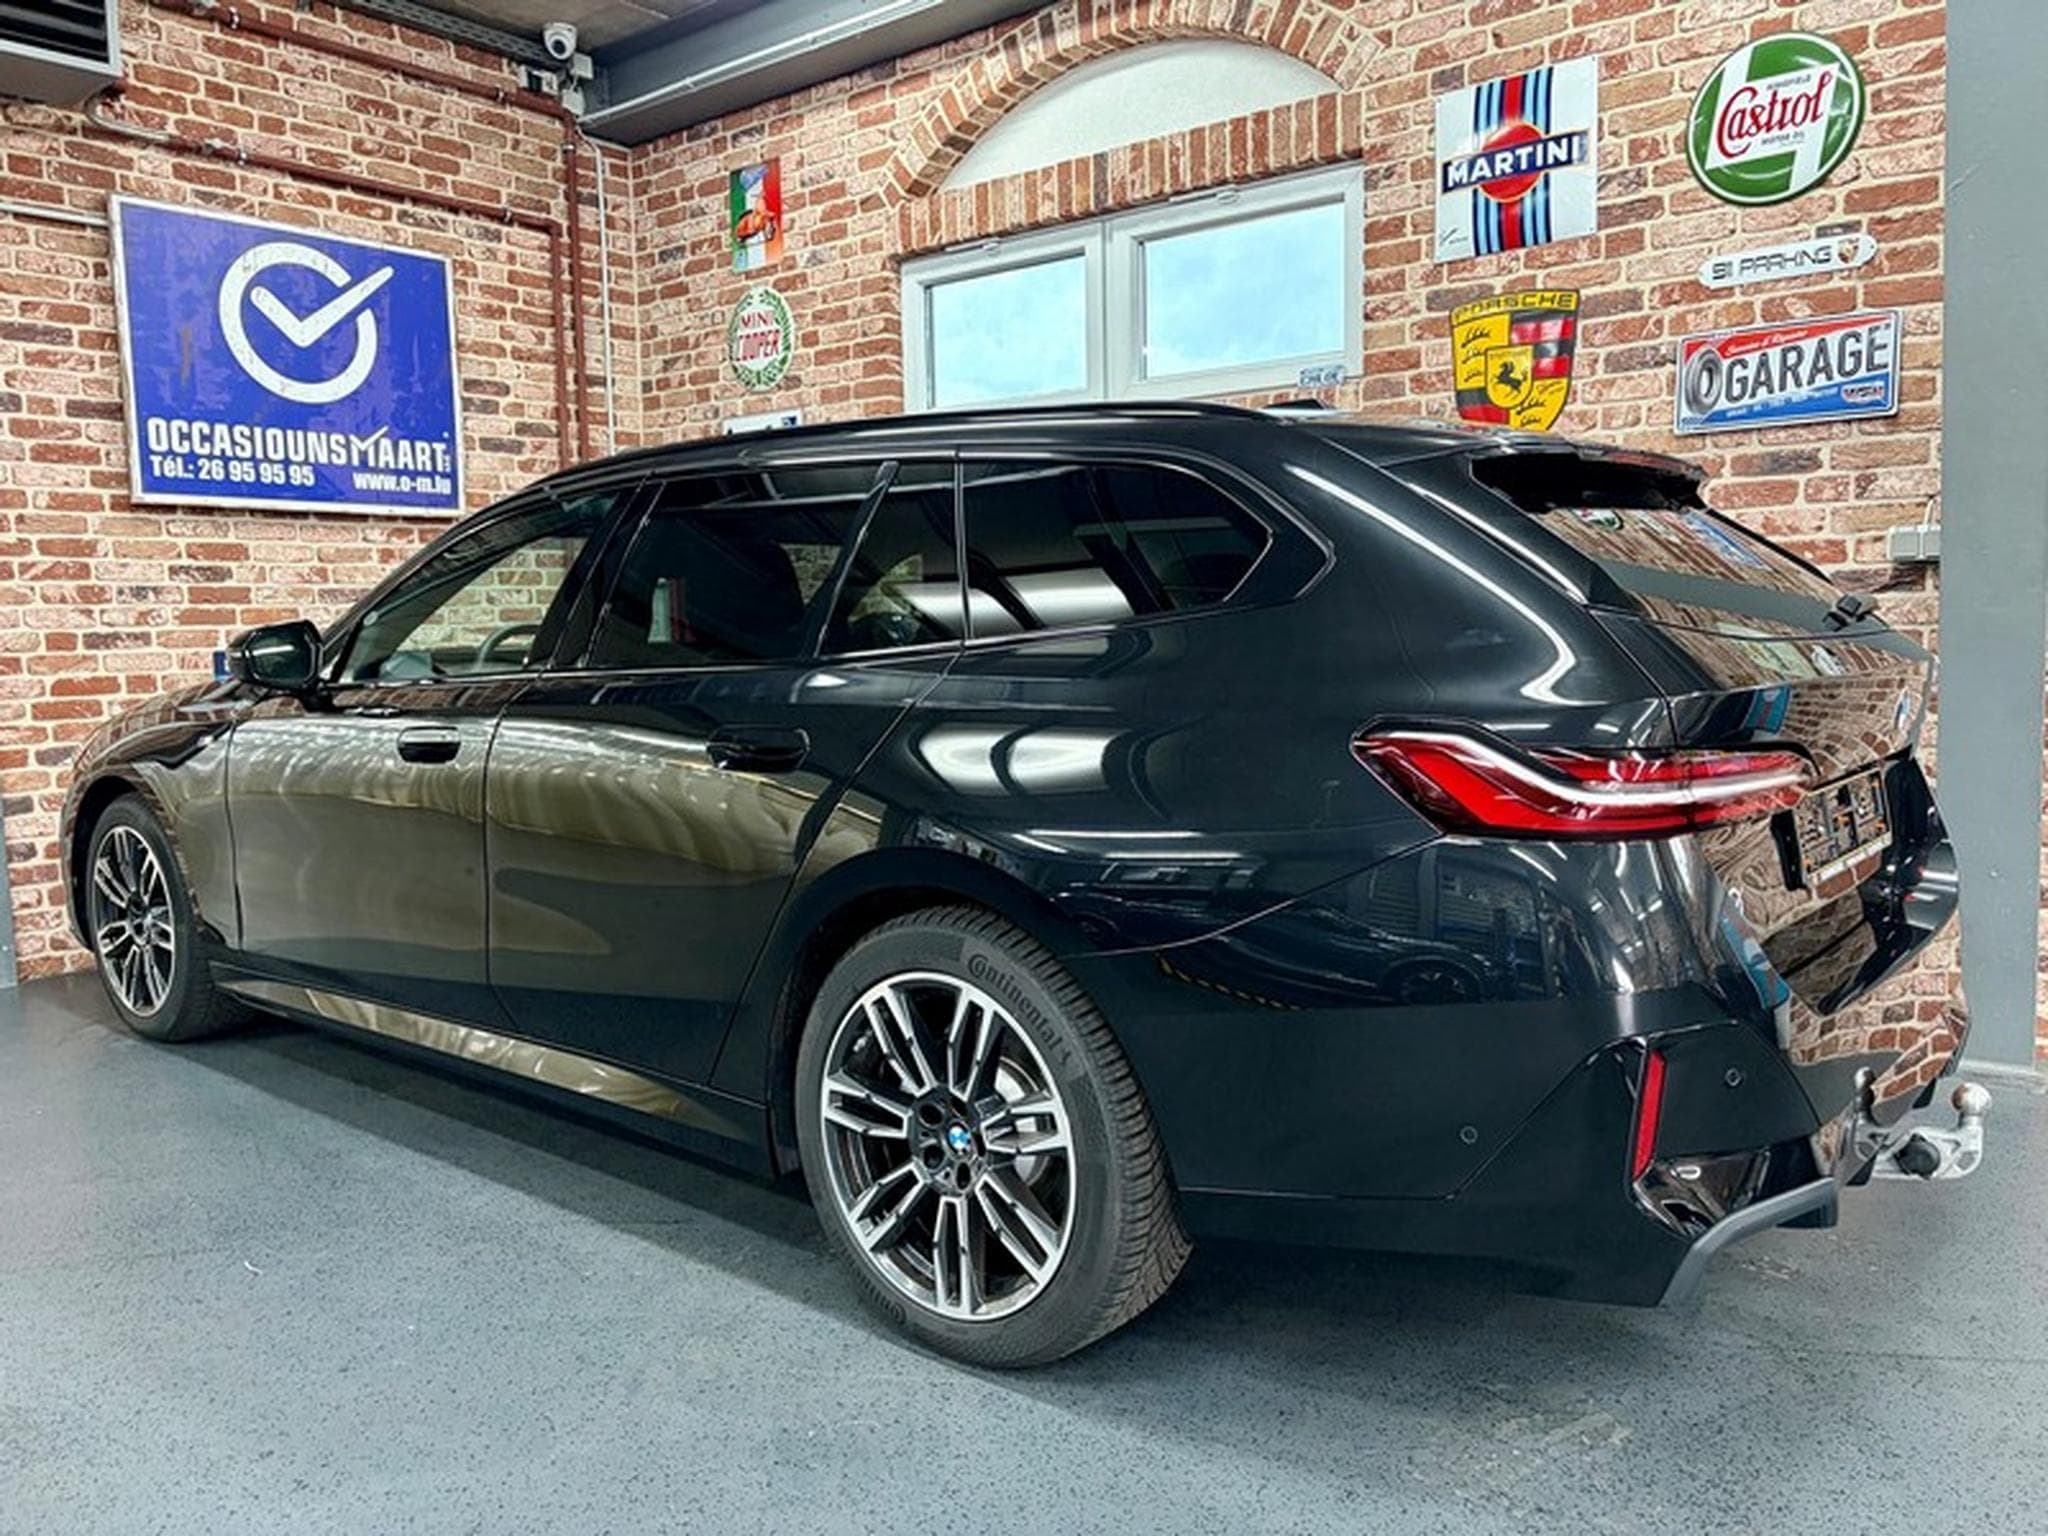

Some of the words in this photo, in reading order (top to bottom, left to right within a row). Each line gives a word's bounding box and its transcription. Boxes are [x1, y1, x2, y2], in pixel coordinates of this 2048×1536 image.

[1715, 70, 1833, 160] Castrol
[1447, 135, 1580, 188] MARTINI
[1738, 245, 1832, 276] PARKING
[740, 310, 774, 328] MINI
[1454, 293, 1574, 323] PORSCHE
[1724, 323, 1891, 403] GARAGE
[146, 417, 447, 473] OCCASIOUNSMAART
[197, 458, 225, 481] 26
[228, 460, 255, 483] 95
[260, 462, 286, 486] 95
[288, 464, 316, 487] 95
[352, 472, 452, 495] www.o-m.lu
[967, 953, 1063, 1050] Continental
